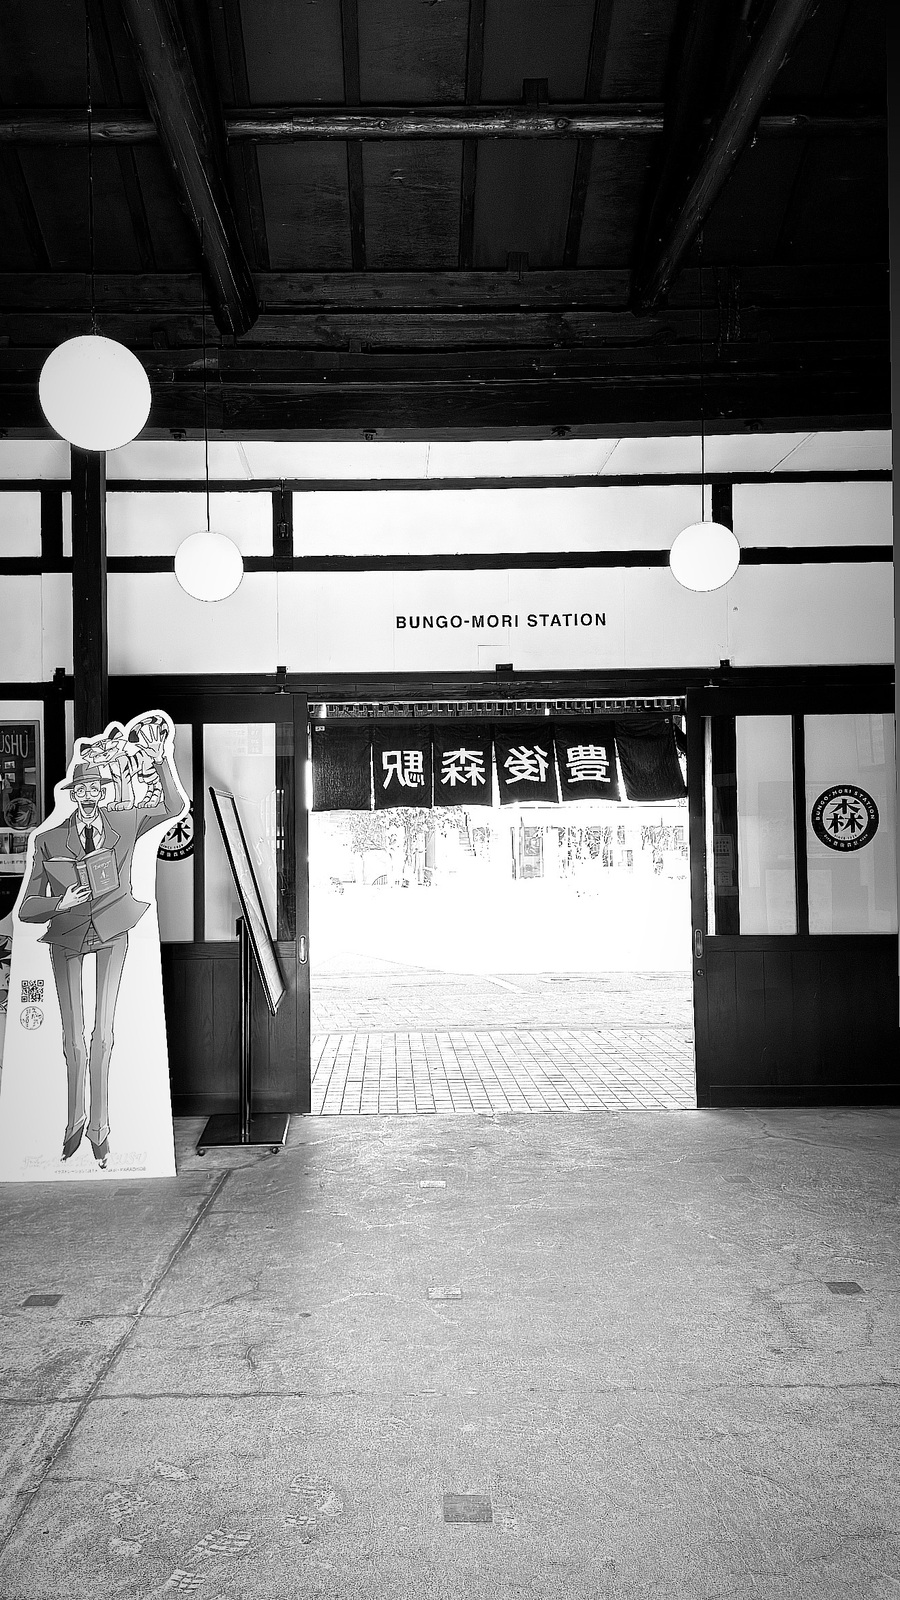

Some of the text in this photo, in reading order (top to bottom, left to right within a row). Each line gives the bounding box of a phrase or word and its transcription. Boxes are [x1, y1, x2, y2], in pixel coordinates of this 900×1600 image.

[396, 612, 607, 629] BUNGO-MORI STATION
[815, 788, 875, 821] BUNGO-MORI STATION
[826, 798, 864, 834] 森
